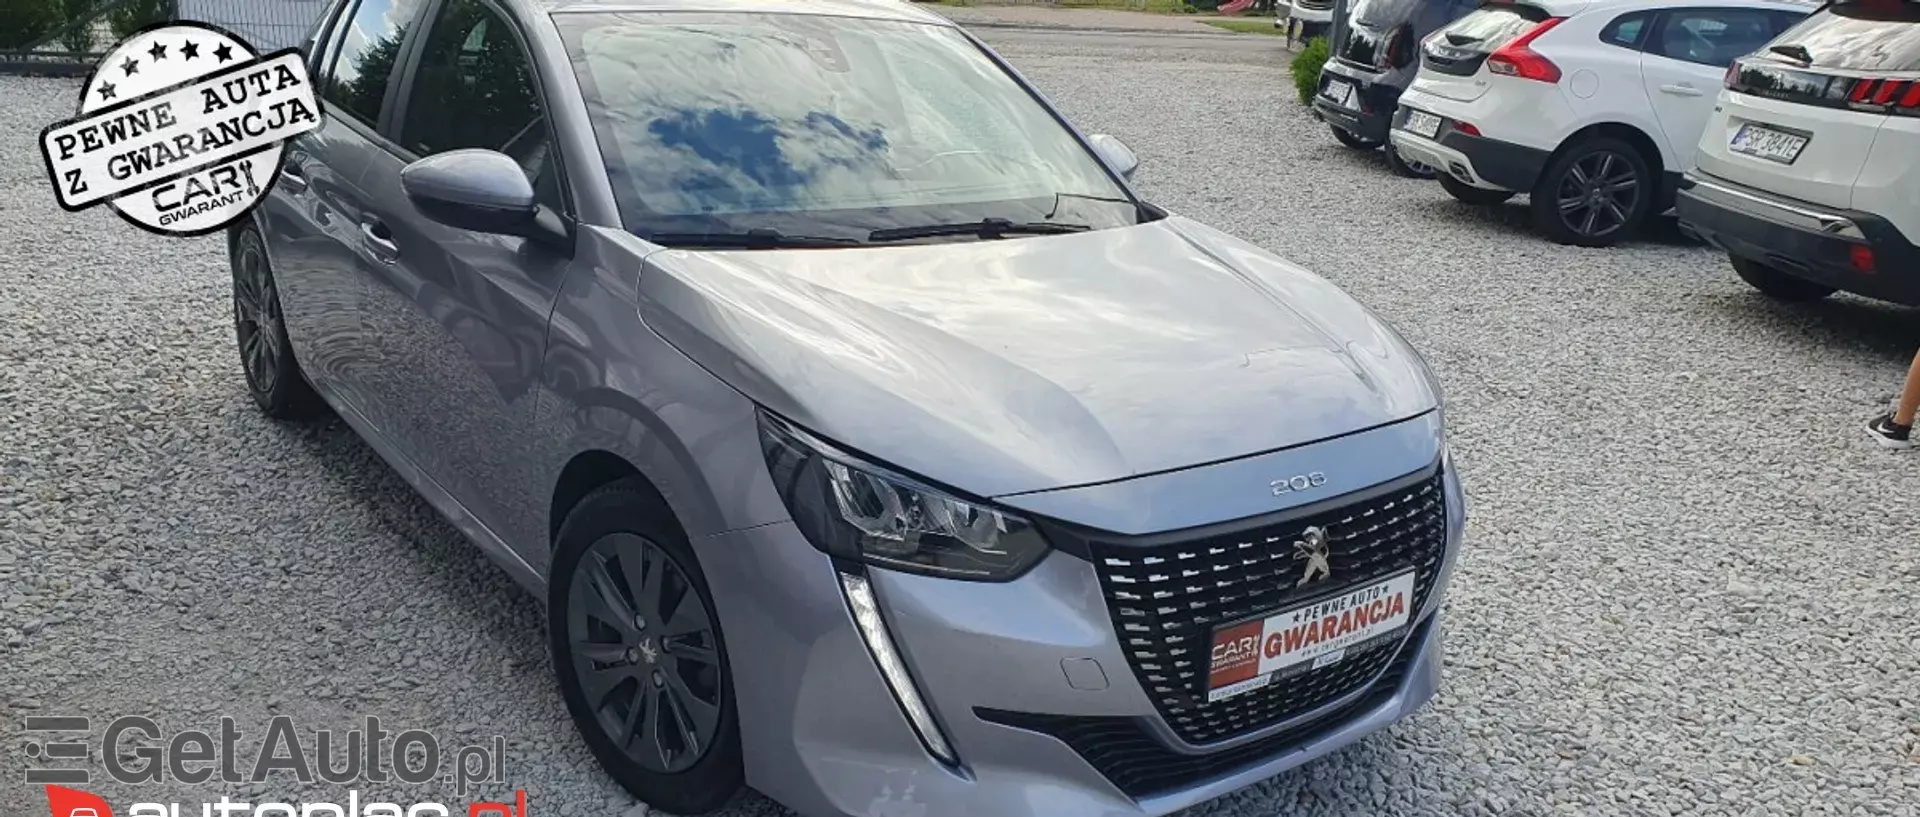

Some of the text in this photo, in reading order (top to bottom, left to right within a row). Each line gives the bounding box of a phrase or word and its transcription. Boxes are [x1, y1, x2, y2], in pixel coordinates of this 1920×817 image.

[1270, 471, 1328, 497] 208
[1303, 585, 1380, 622] PEWNE AUTO
[1264, 592, 1405, 659] GWARANCJA
[1211, 636, 1253, 661] CAR
